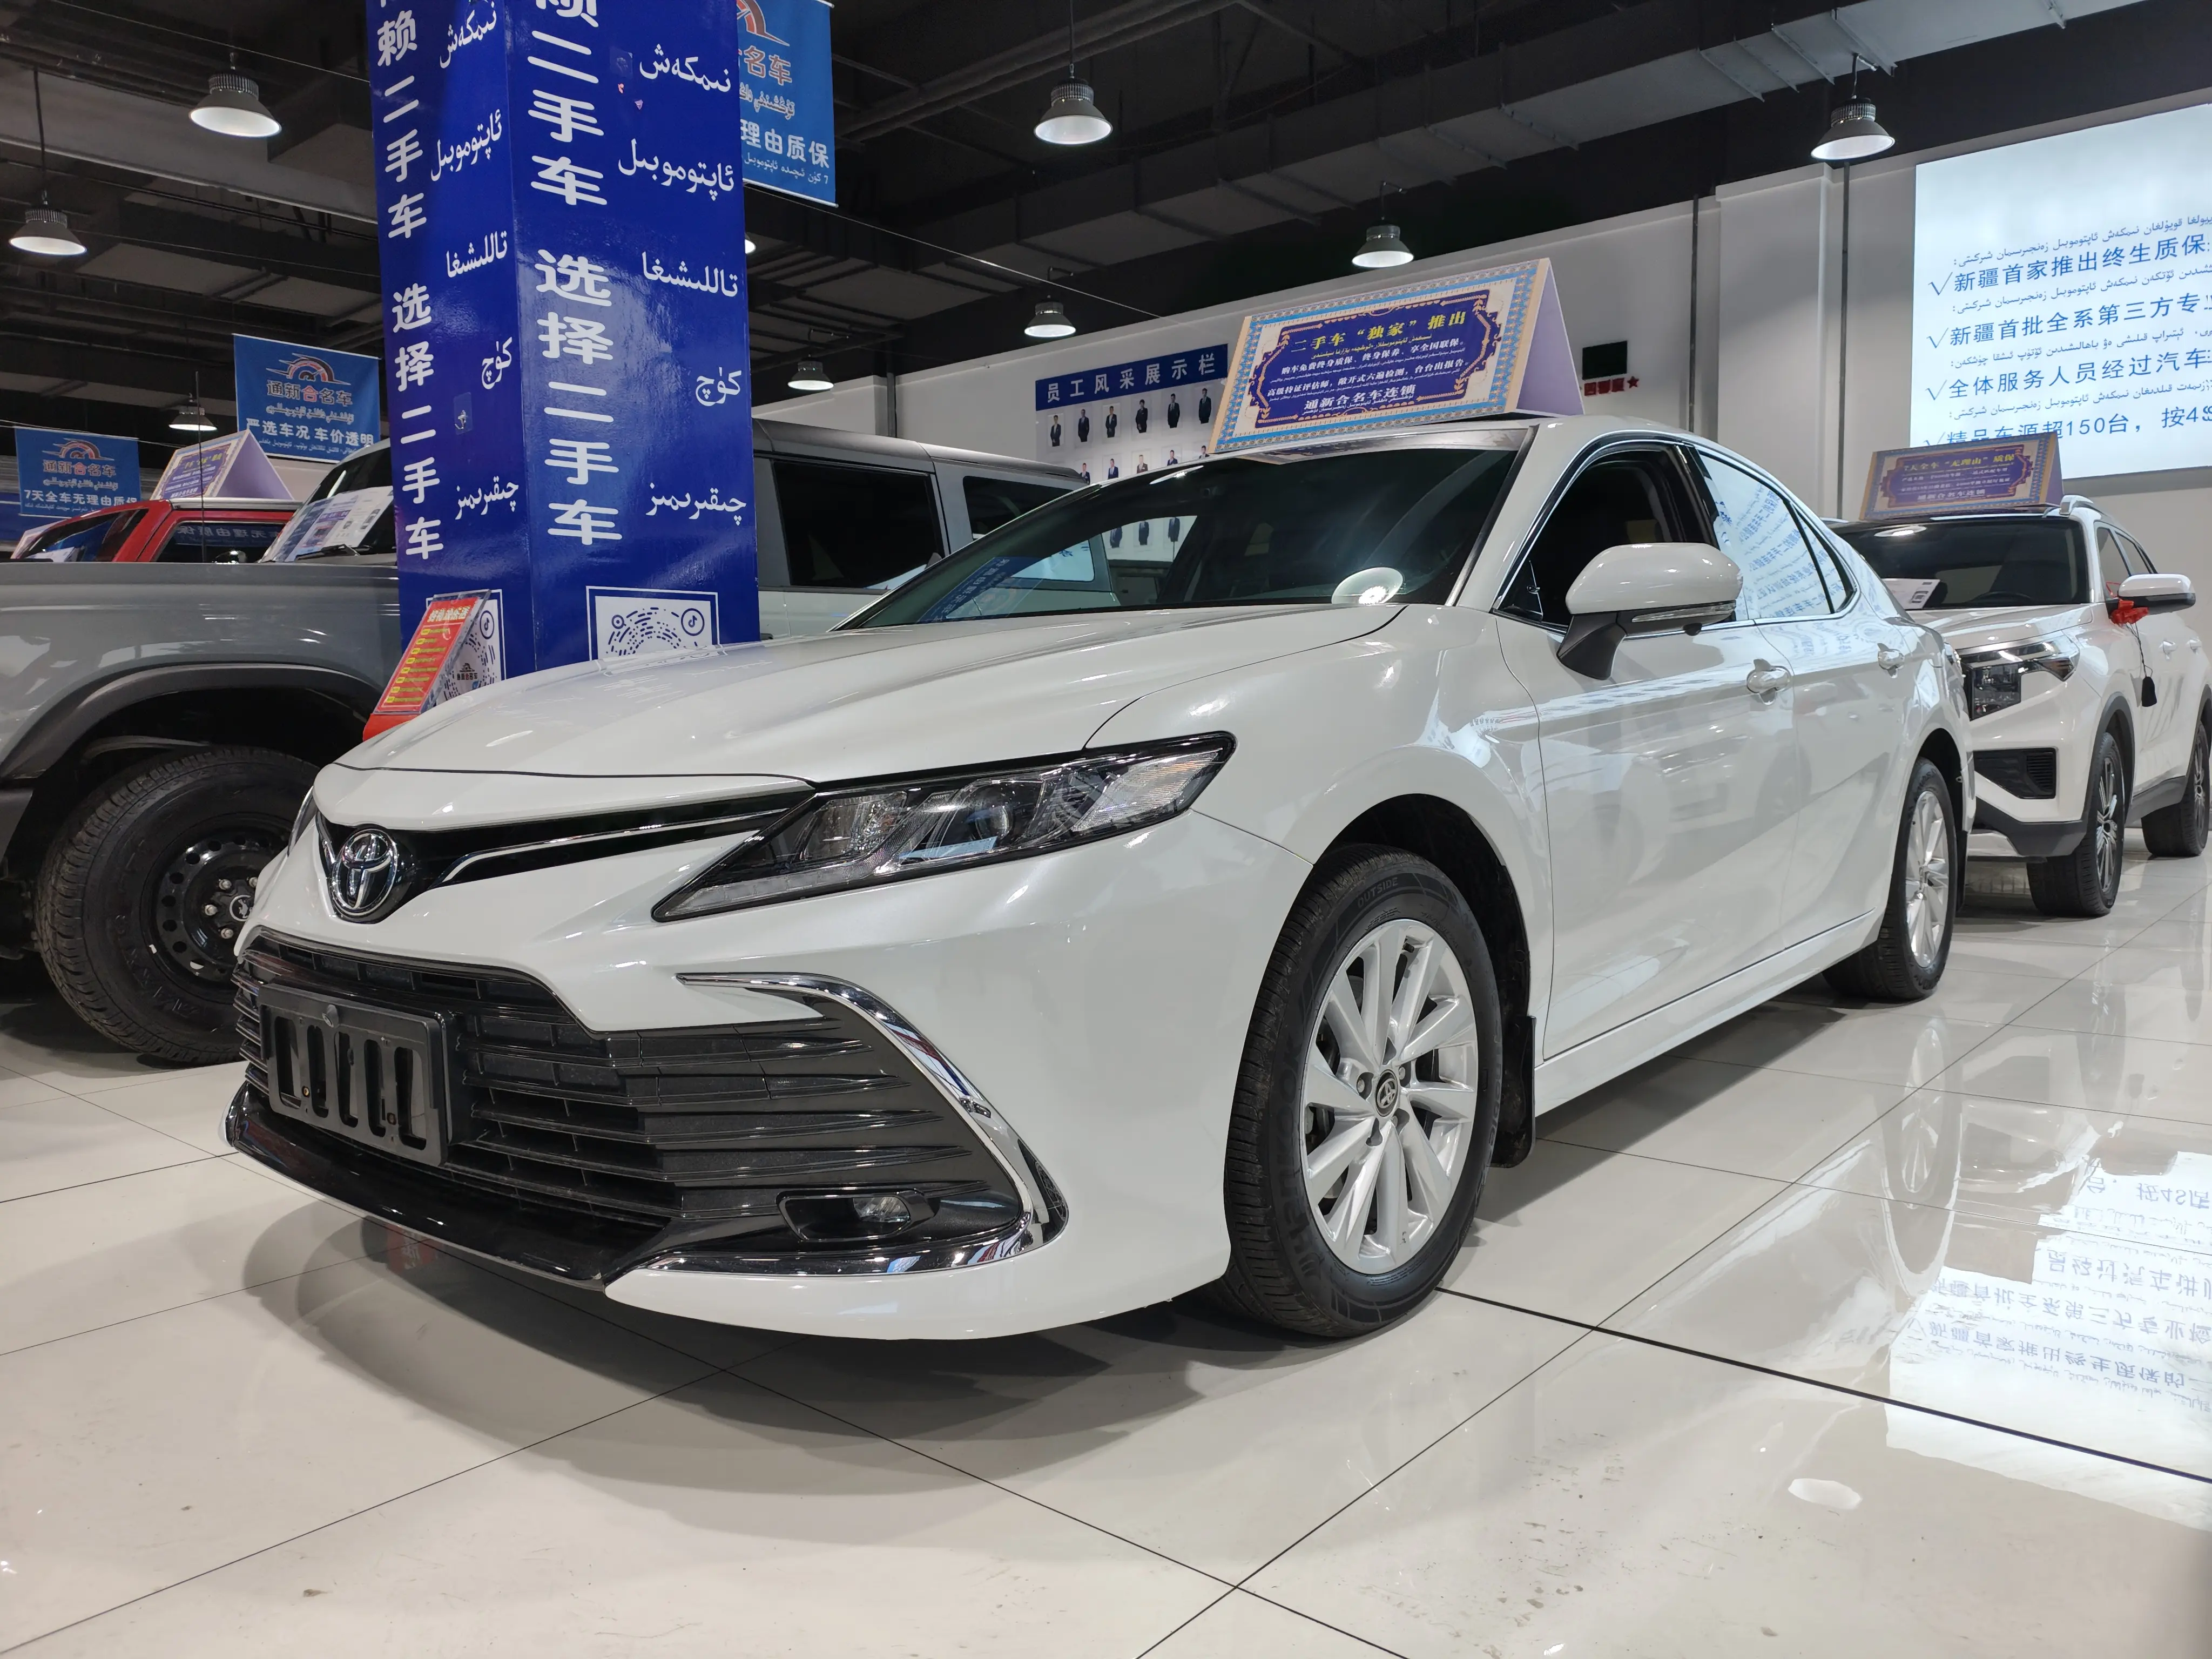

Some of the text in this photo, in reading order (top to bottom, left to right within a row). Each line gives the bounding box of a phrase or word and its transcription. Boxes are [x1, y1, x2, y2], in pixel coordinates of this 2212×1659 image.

[740, 118, 830, 168] 理由质保
[267, 379, 353, 407] 通新合名车
[1047, 352, 1216, 403] 员工风采展示栏
[535, 249, 622, 545] 选择二手车
[1304, 384, 1417, 410] 通新合名车连锁
[246, 417, 311, 440] 严选车况
[314, 426, 374, 447] 车价透明
[392, 283, 444, 559] 选择二手车
[43, 459, 117, 478] 通新合名车
[1357, 876, 1399, 909] OUTSIDE
